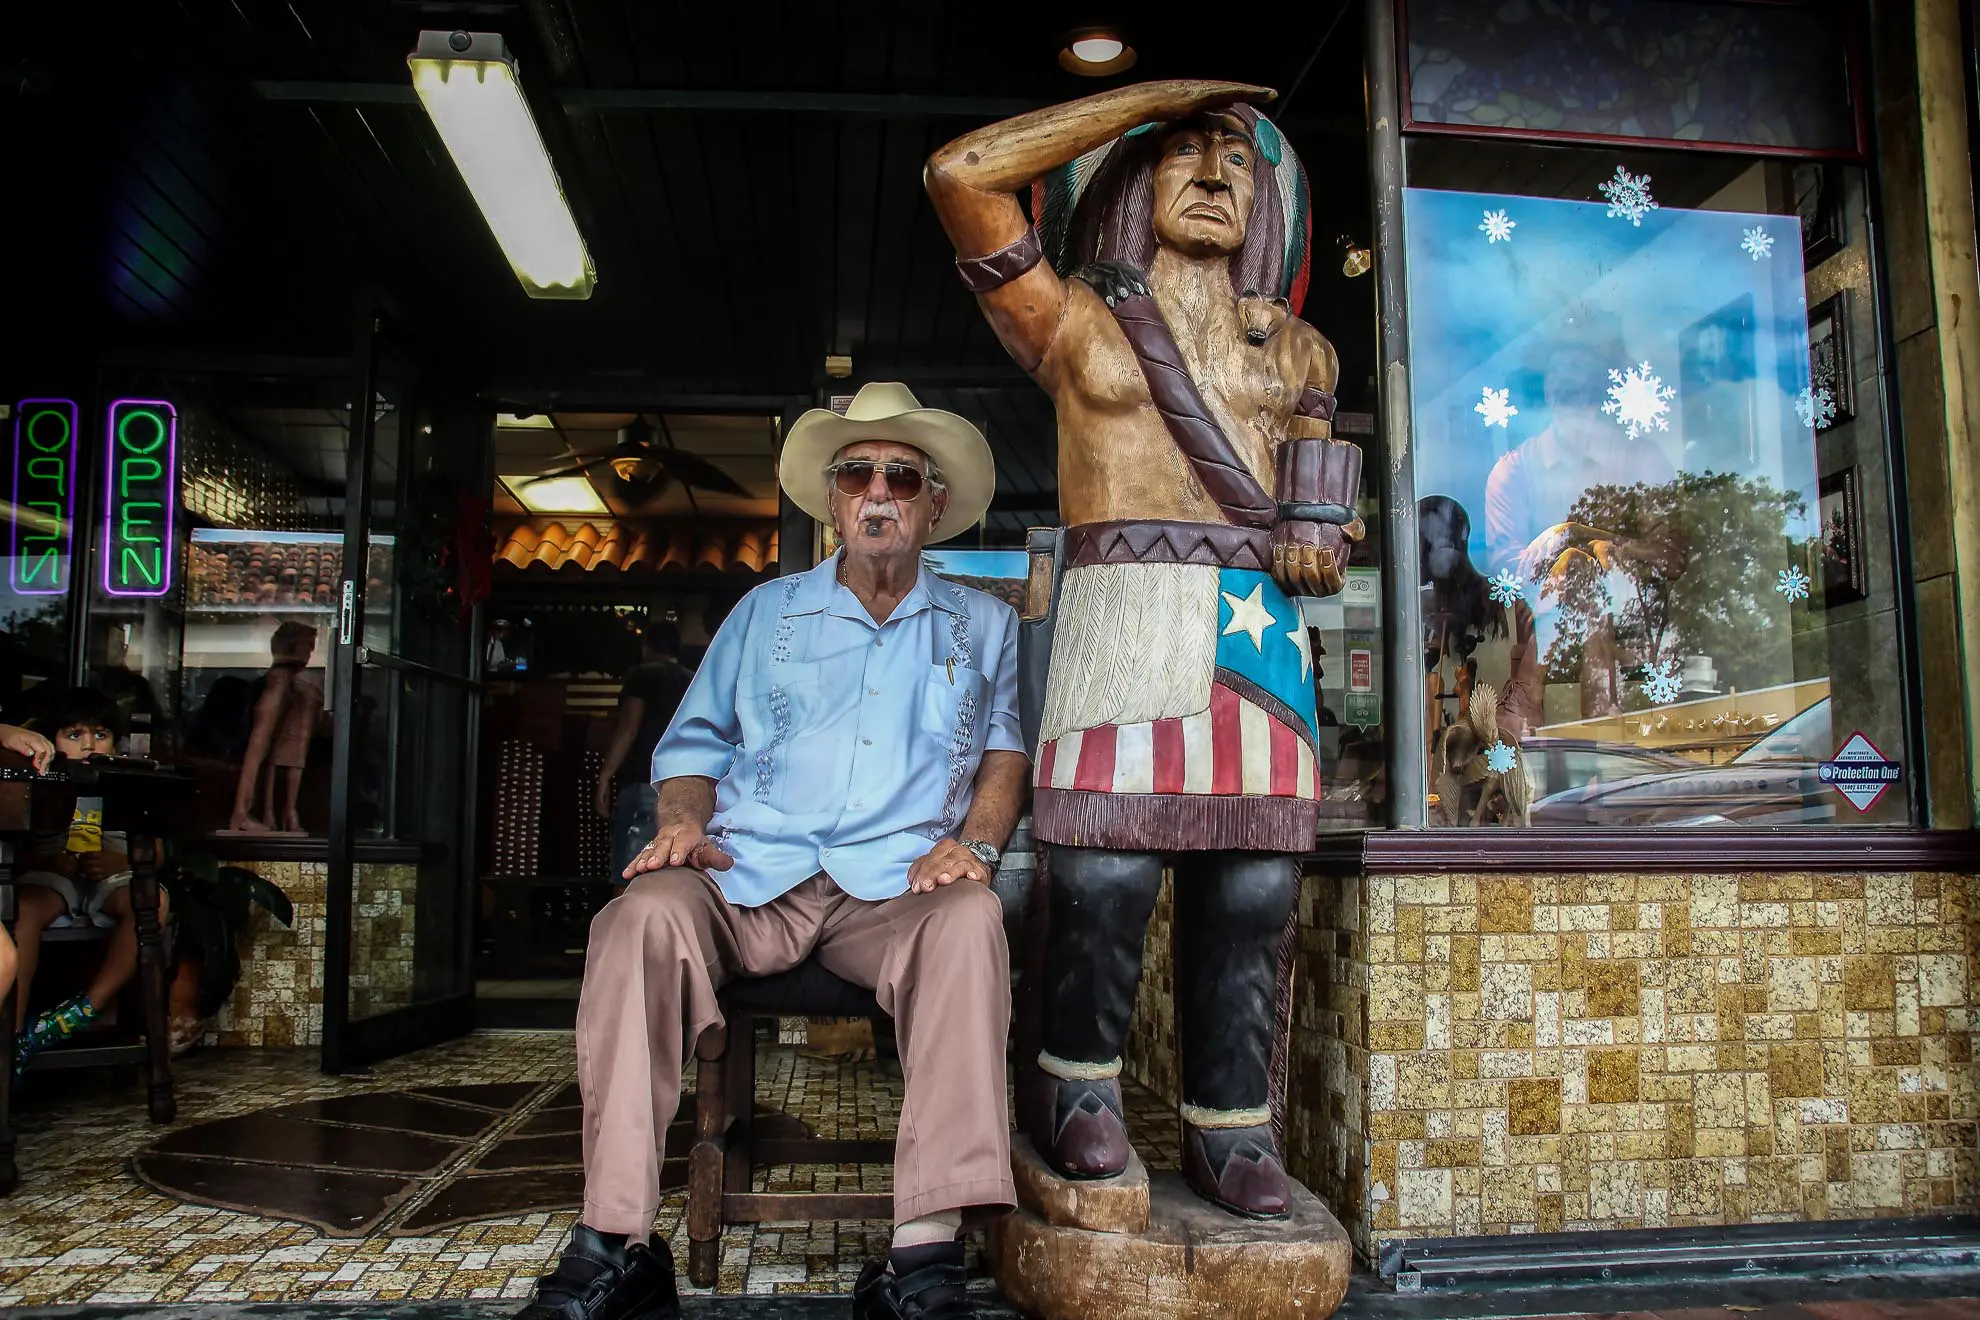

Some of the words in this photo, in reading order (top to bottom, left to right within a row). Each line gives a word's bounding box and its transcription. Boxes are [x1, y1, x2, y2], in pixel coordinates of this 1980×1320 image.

[118, 410, 166, 586] OPEN
[1832, 766, 1879, 779] Protection
[1881, 766, 1899, 779] One
